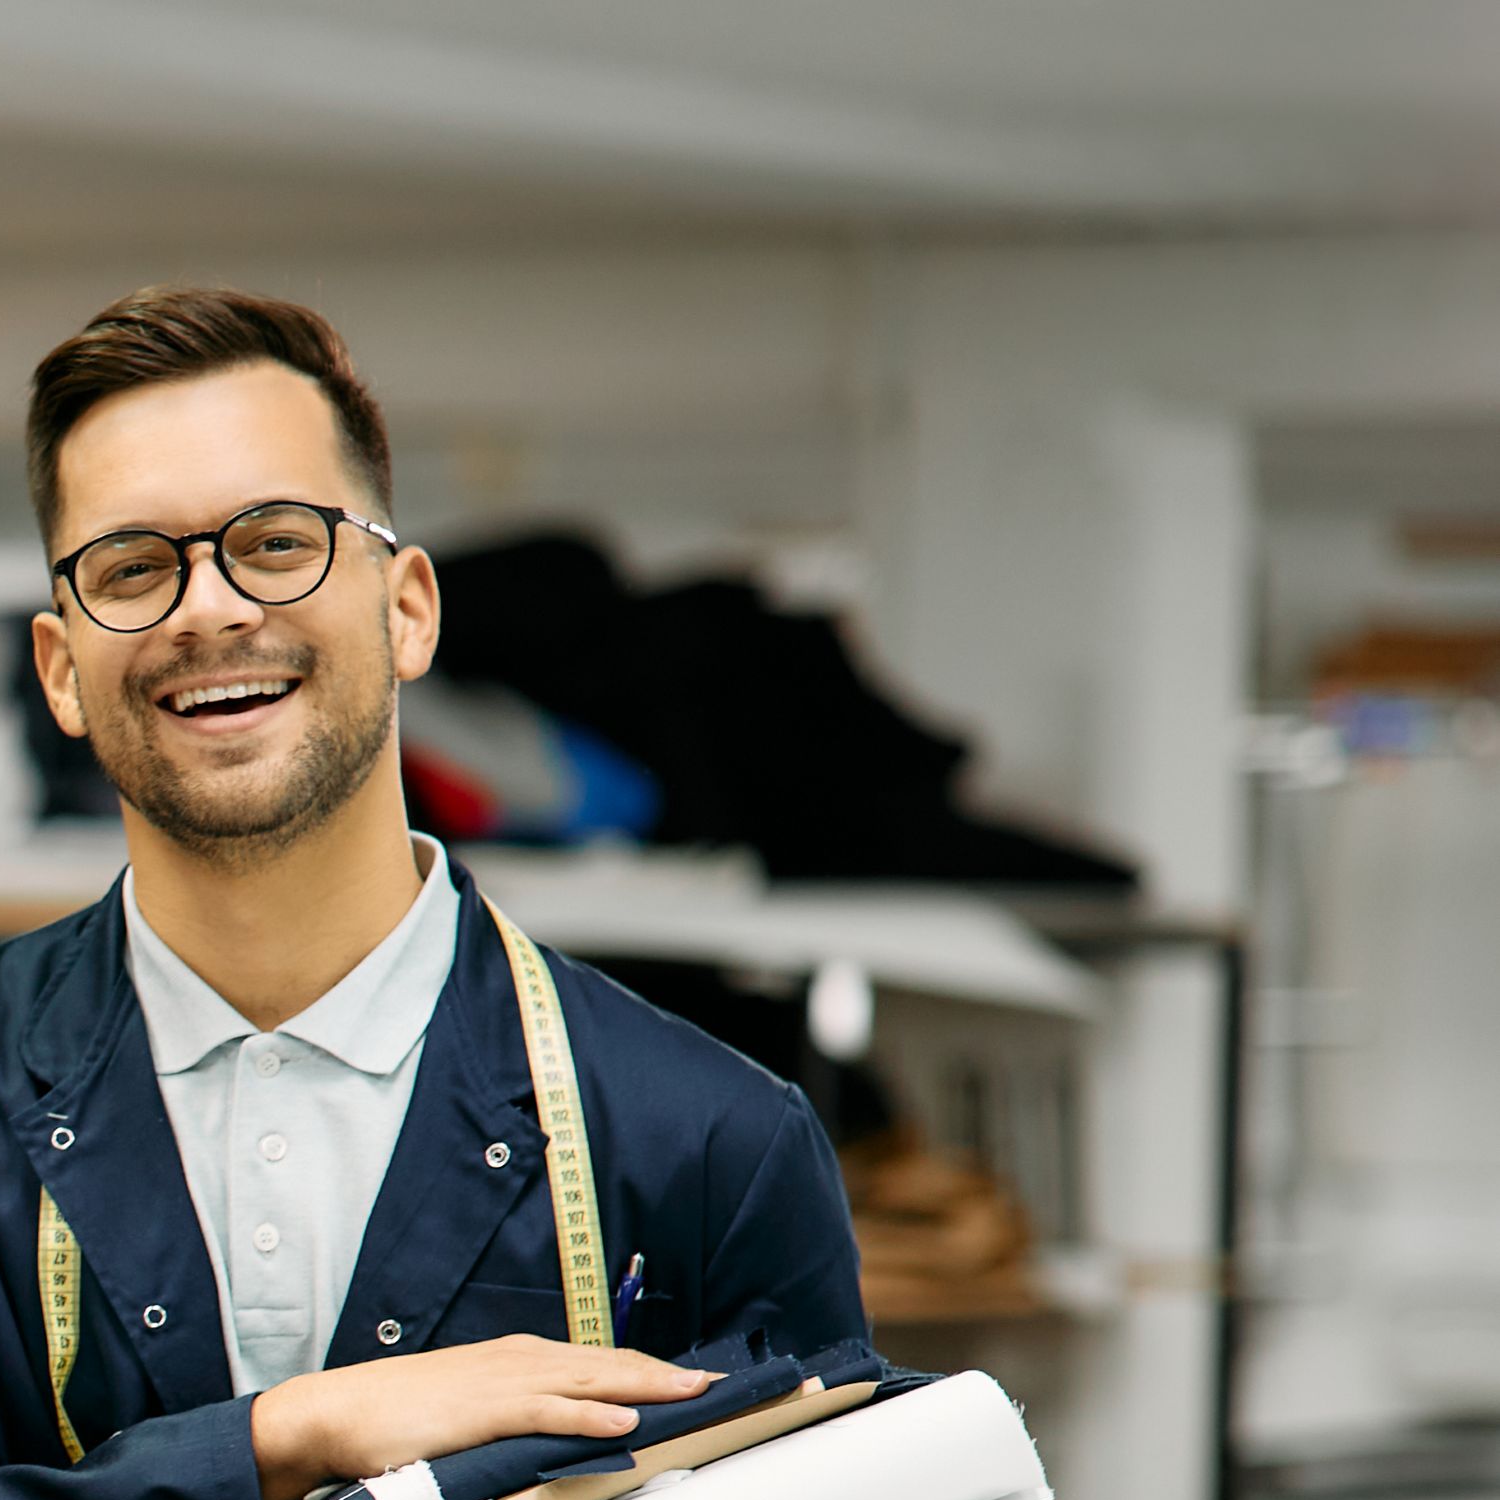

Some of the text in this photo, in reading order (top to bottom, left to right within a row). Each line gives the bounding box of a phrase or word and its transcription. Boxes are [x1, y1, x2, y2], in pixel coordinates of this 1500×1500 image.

[547, 1090, 565, 1101] 101
[551, 1110, 568, 1121] 102
[558, 1150, 575, 1161] 104
[560, 1170, 580, 1182] 105
[567, 1211, 584, 1224] 107
[570, 1233, 589, 1244] 108
[54, 1253, 67, 1265] 47
[573, 1255, 591, 1267] 109
[576, 1276, 594, 1288] 110
[578, 1297, 596, 1309] 111
[581, 1319, 598, 1331] 112
